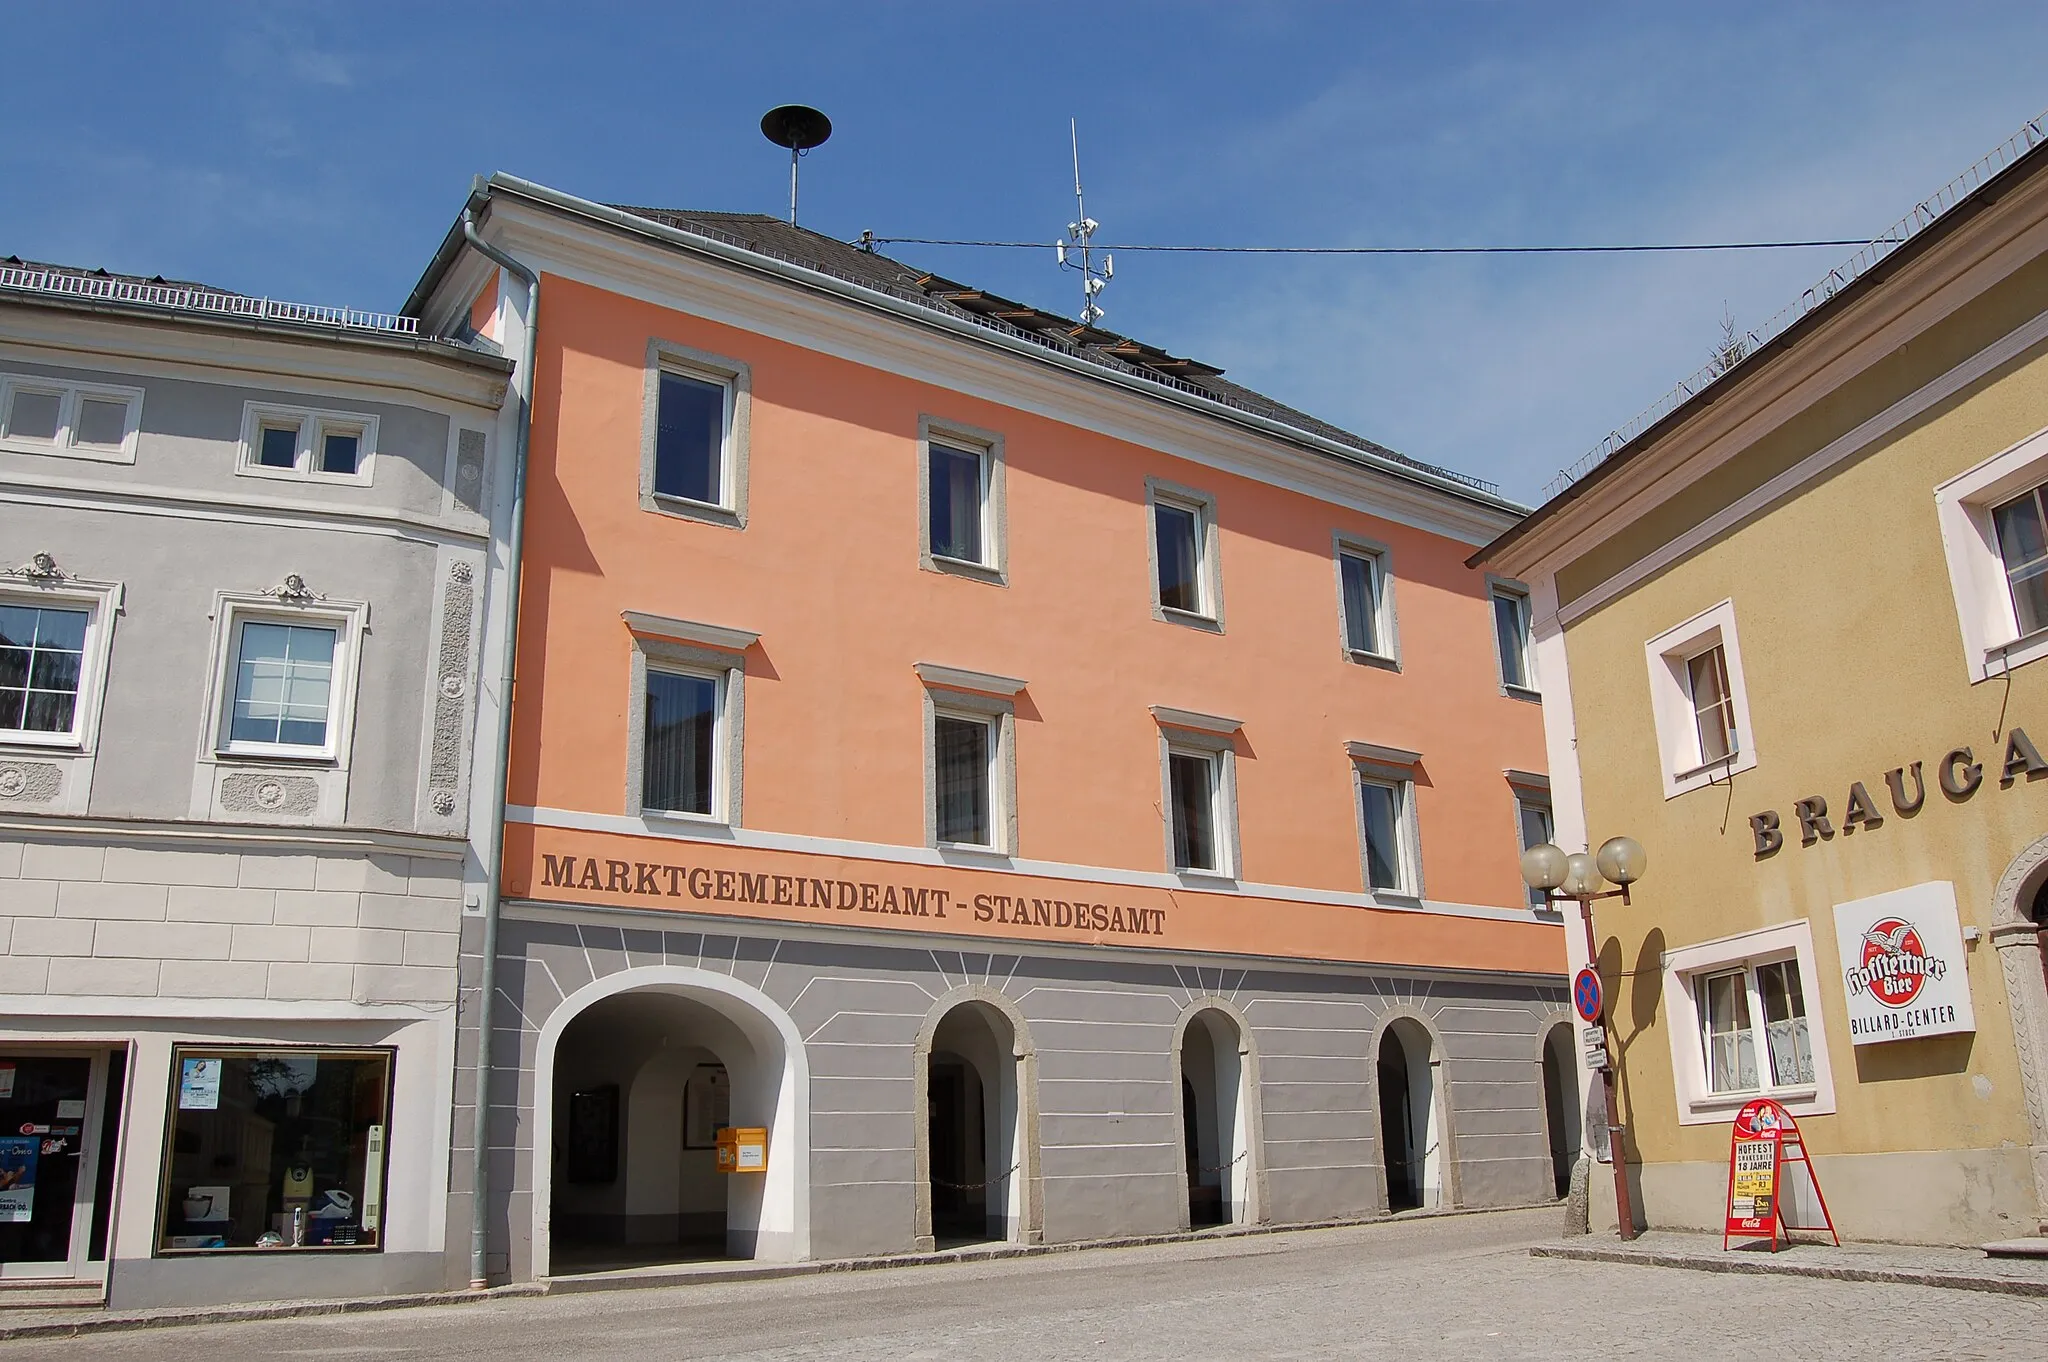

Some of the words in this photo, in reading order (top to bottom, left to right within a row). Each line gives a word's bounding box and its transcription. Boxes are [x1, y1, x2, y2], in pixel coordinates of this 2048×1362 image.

[1748, 727, 2048, 862] BRAUGA
[541, 854, 949, 918] MARKTGEMEINDEAMT
[974, 894, 1165, 936] STANDESAMT
[1883, 975, 1912, 996] Bier
[1851, 1005, 1955, 1035] BILLARD-CENTER
[1738, 1143, 1772, 1155] HOFFEST
[1738, 1162, 1748, 1171] 18
[1750, 1161, 1772, 1170] JAHRE
